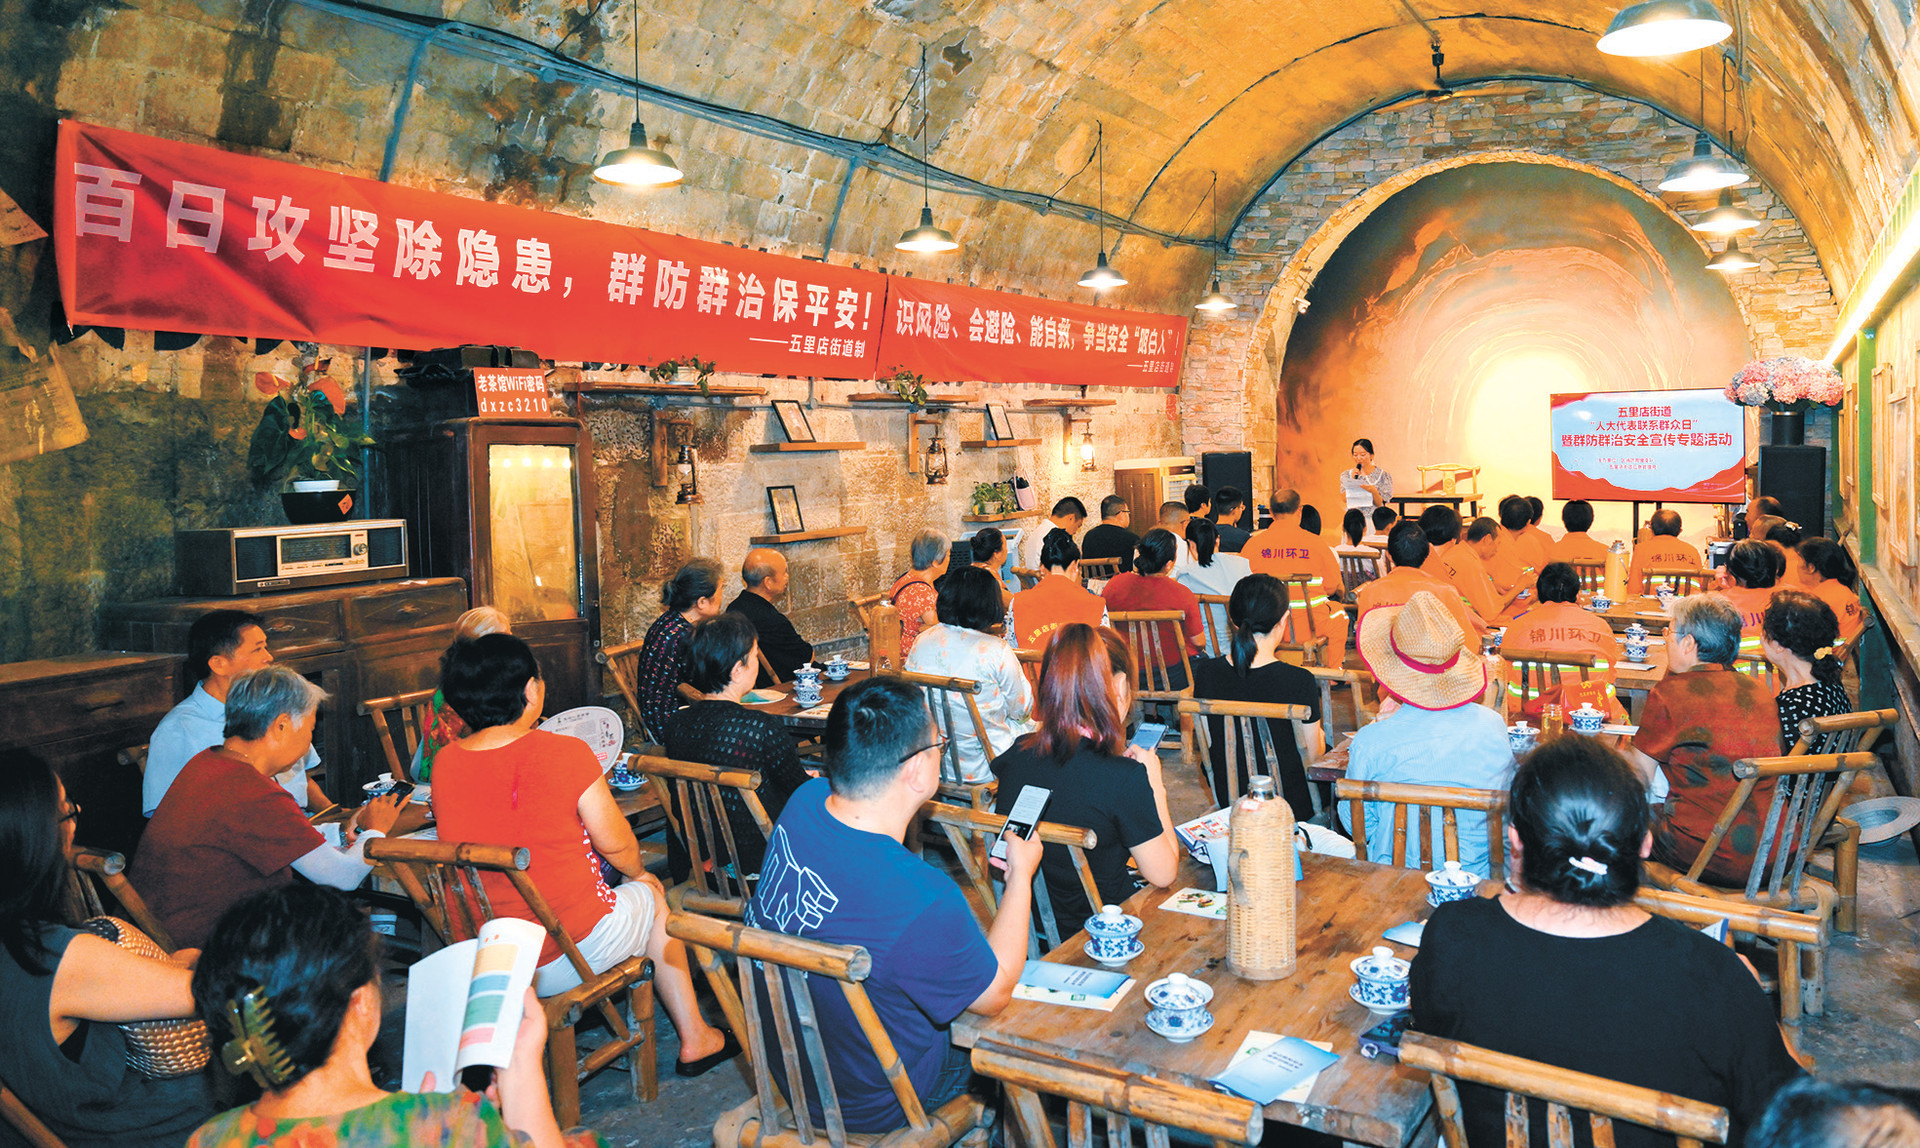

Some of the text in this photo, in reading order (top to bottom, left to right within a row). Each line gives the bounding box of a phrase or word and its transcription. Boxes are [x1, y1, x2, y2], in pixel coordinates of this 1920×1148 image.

[478, 374, 545, 392] 老茶馆WiFi密码
[480, 397, 548, 412] dxzc3210
[1618, 406, 1672, 418] 五里店街道
[1590, 418, 1698, 431] “人大代表联系群众日”
[1562, 432, 1733, 447] 暨群防群治安全宣传专题活动
[1261, 548, 1310, 560] 锦川环卫
